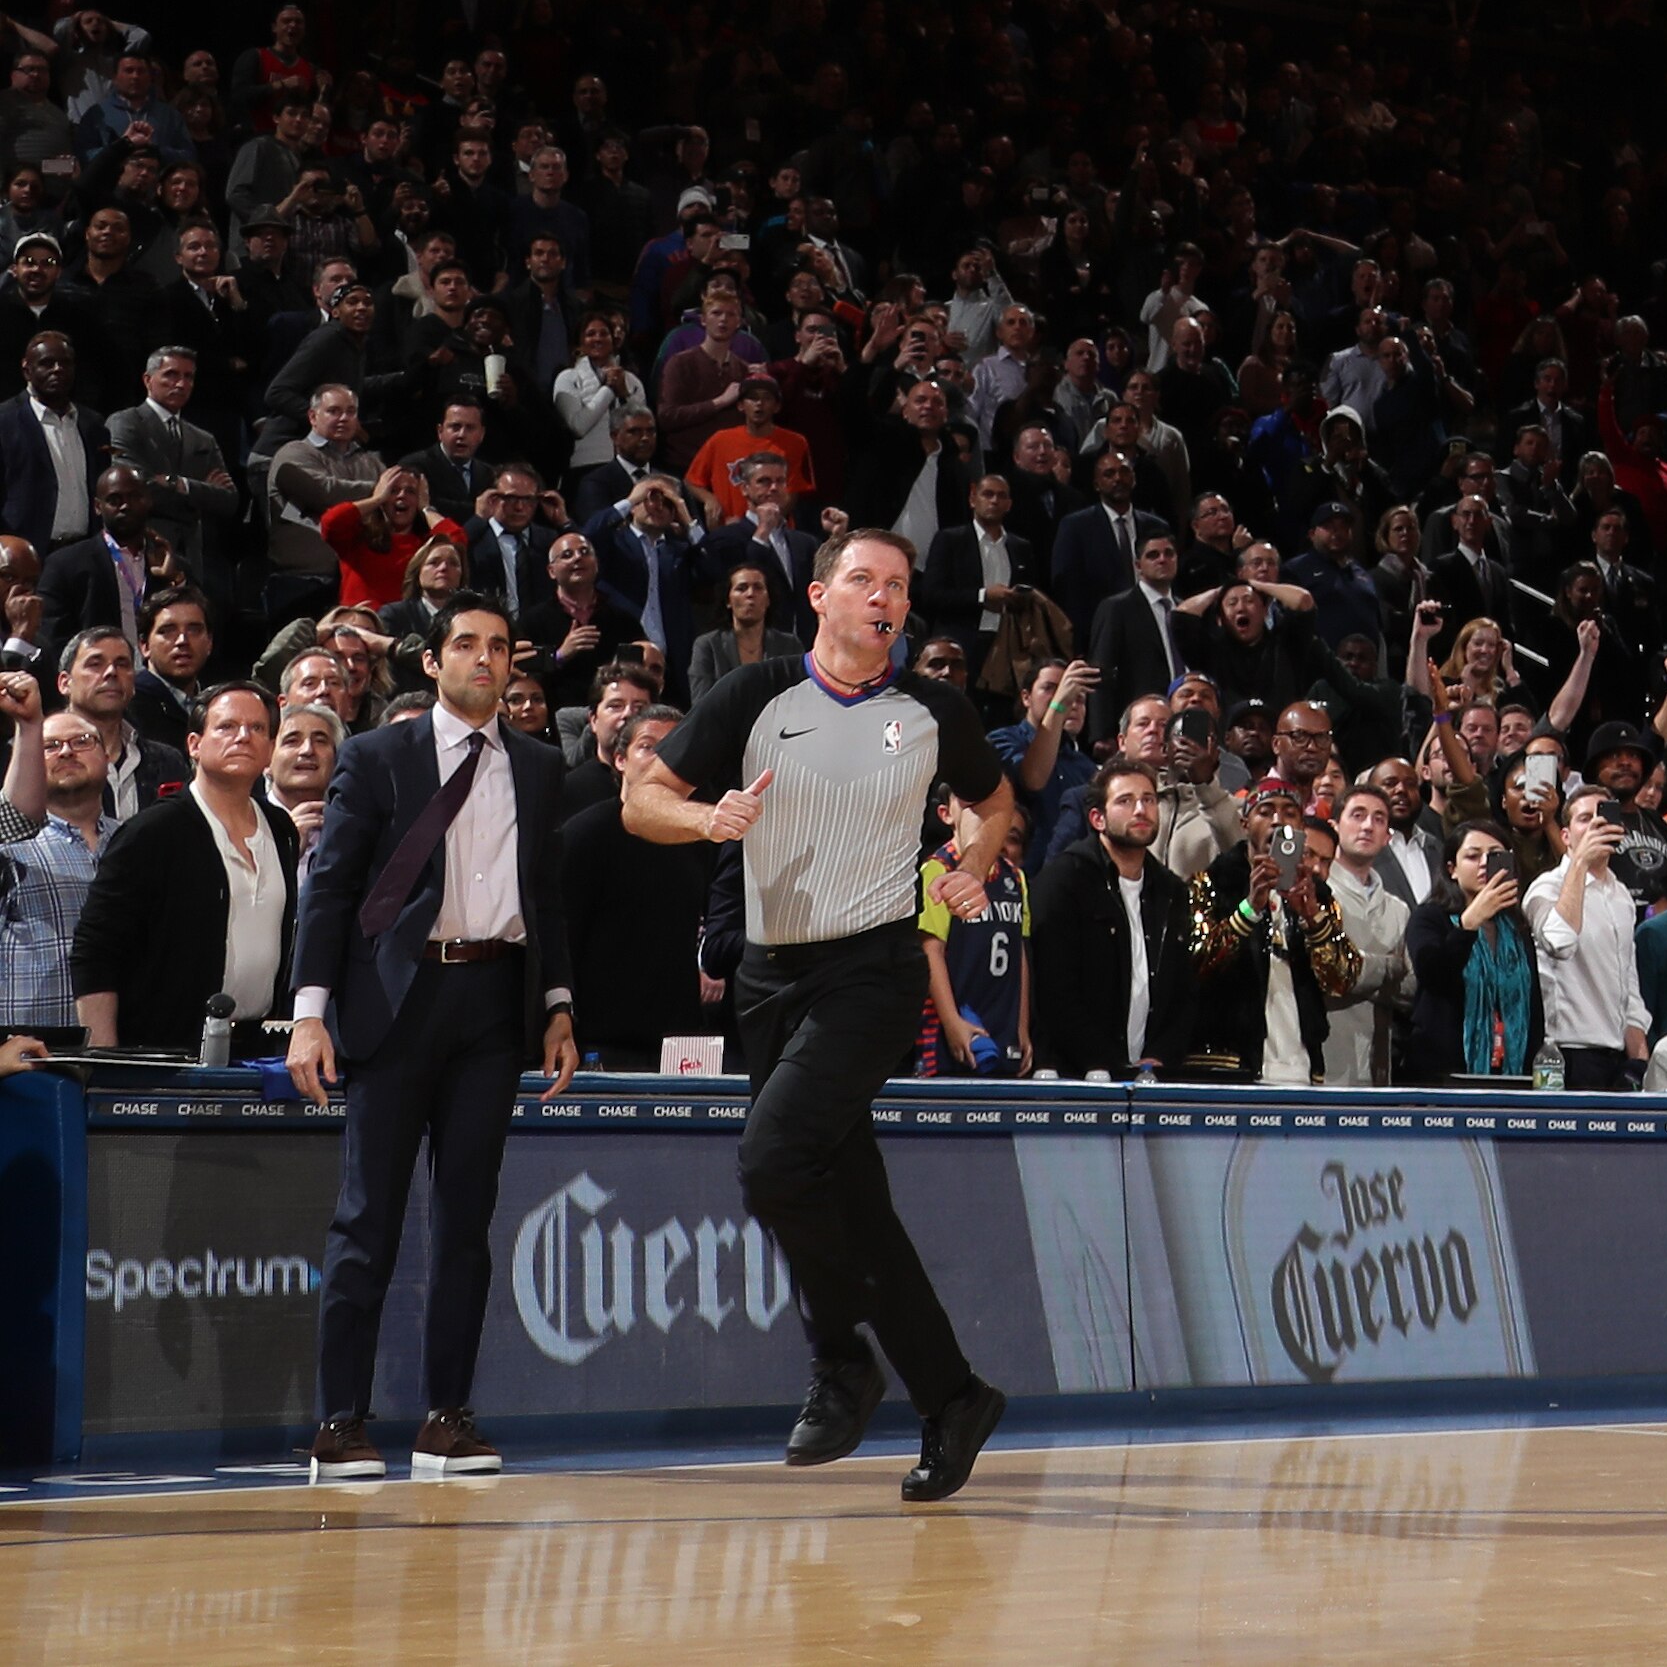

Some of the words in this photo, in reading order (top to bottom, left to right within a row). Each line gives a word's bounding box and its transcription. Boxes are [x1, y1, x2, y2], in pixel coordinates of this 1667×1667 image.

[989, 931, 1010, 978] 6
[112, 1103, 158, 1115] CHASE
[177, 1103, 222, 1116] CHASE
[241, 1104, 285, 1116] CHASE
[304, 1104, 346, 1116] CHASE
[541, 1105, 581, 1117] CHASE
[598, 1105, 637, 1117] CHASE
[653, 1106, 691, 1117] CHASE
[708, 1107, 746, 1118] CHASE
[871, 1110, 902, 1122] HASE
[916, 1112, 952, 1123] CHASE
[966, 1112, 1001, 1123] CHASE
[1015, 1112, 1050, 1123] CHASE
[1063, 1112, 1098, 1123] CHASE
[1158, 1114, 1192, 1126] CHASE
[1204, 1115, 1237, 1126] CHASE
[1249, 1115, 1282, 1126] CHASE
[1294, 1115, 1326, 1126] CHASE
[1338, 1116, 1369, 1127] CHASE
[1381, 1116, 1412, 1127] CHASE
[1424, 1117, 1454, 1127] CHASE
[1466, 1117, 1496, 1128] CHASE
[1507, 1119, 1537, 1129] CHASE
[1548, 1120, 1577, 1130] CHASE
[1588, 1121, 1617, 1132] CHASE
[1627, 1122, 1656, 1132] CHASE
[85, 1248, 312, 1313] Spectrum
[512, 1171, 806, 1366] Cuerv
[1271, 1220, 1478, 1384] Cuervo
